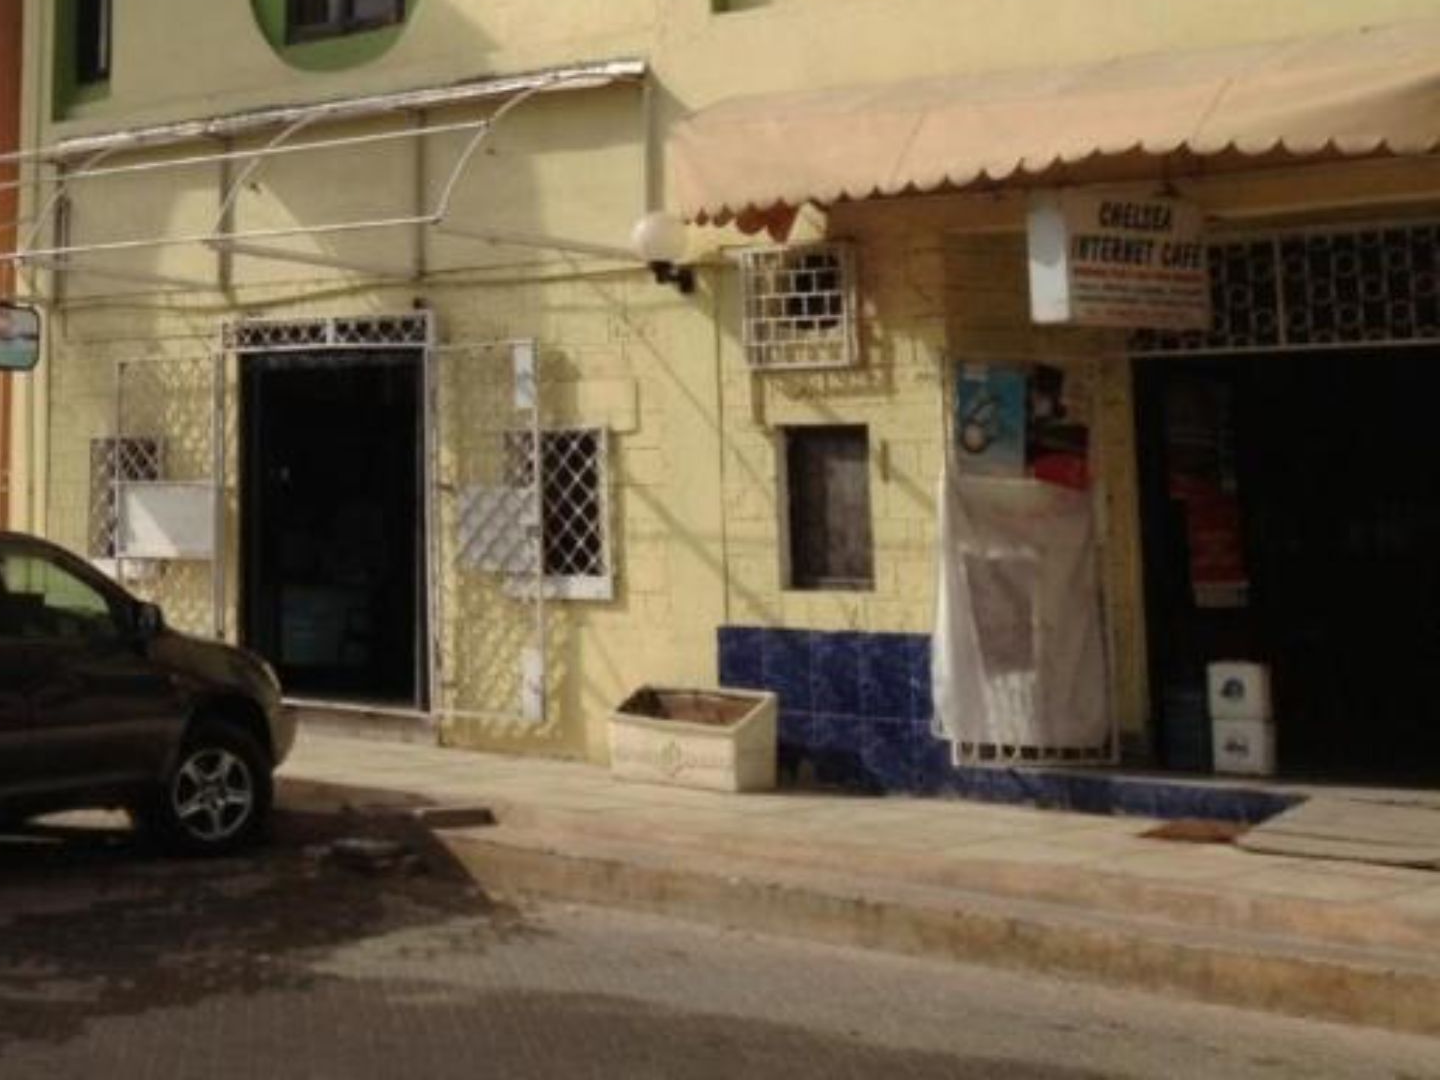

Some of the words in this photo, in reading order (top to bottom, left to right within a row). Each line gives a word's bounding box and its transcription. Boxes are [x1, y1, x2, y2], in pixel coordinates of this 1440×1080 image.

[1098, 201, 1172, 231] CHELSEA
[1071, 234, 1154, 264] INTERNET
[1161, 241, 1202, 269] CAFE
